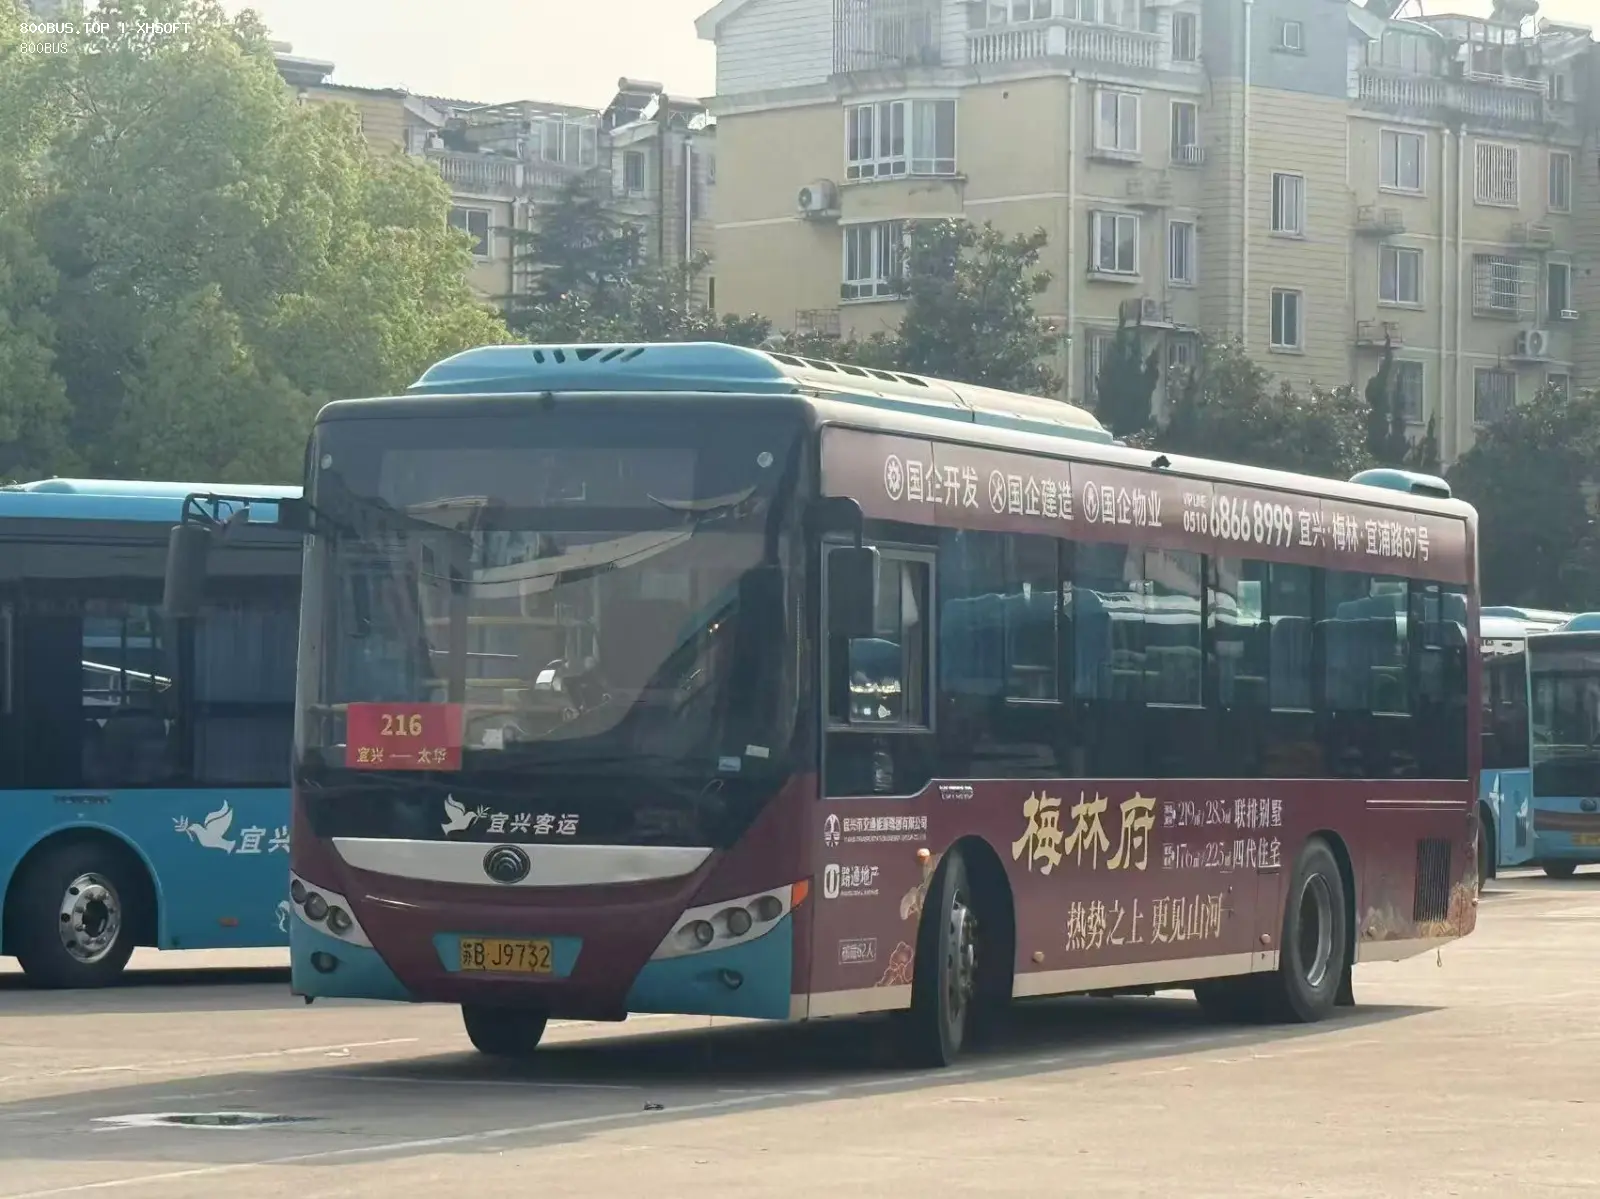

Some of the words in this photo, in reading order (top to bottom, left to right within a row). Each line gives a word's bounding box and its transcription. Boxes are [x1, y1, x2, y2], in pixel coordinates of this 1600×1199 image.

[906, 459, 979, 508] 国企开发
[1008, 474, 1074, 521] 国企建造
[1101, 486, 1162, 527] 国企物业
[1183, 510, 1208, 535] 0510
[1210, 494, 1250, 542] 6866
[1253, 500, 1293, 548] 8999
[380, 713, 422, 736] 216
[357, 746, 384, 763] 宜兴
[417, 747, 448, 764] 太华
[487, 812, 580, 835] 宜兴客运
[1011, 789, 1157, 875] 梅林府
[1151, 891, 1224, 945] 更见山河
